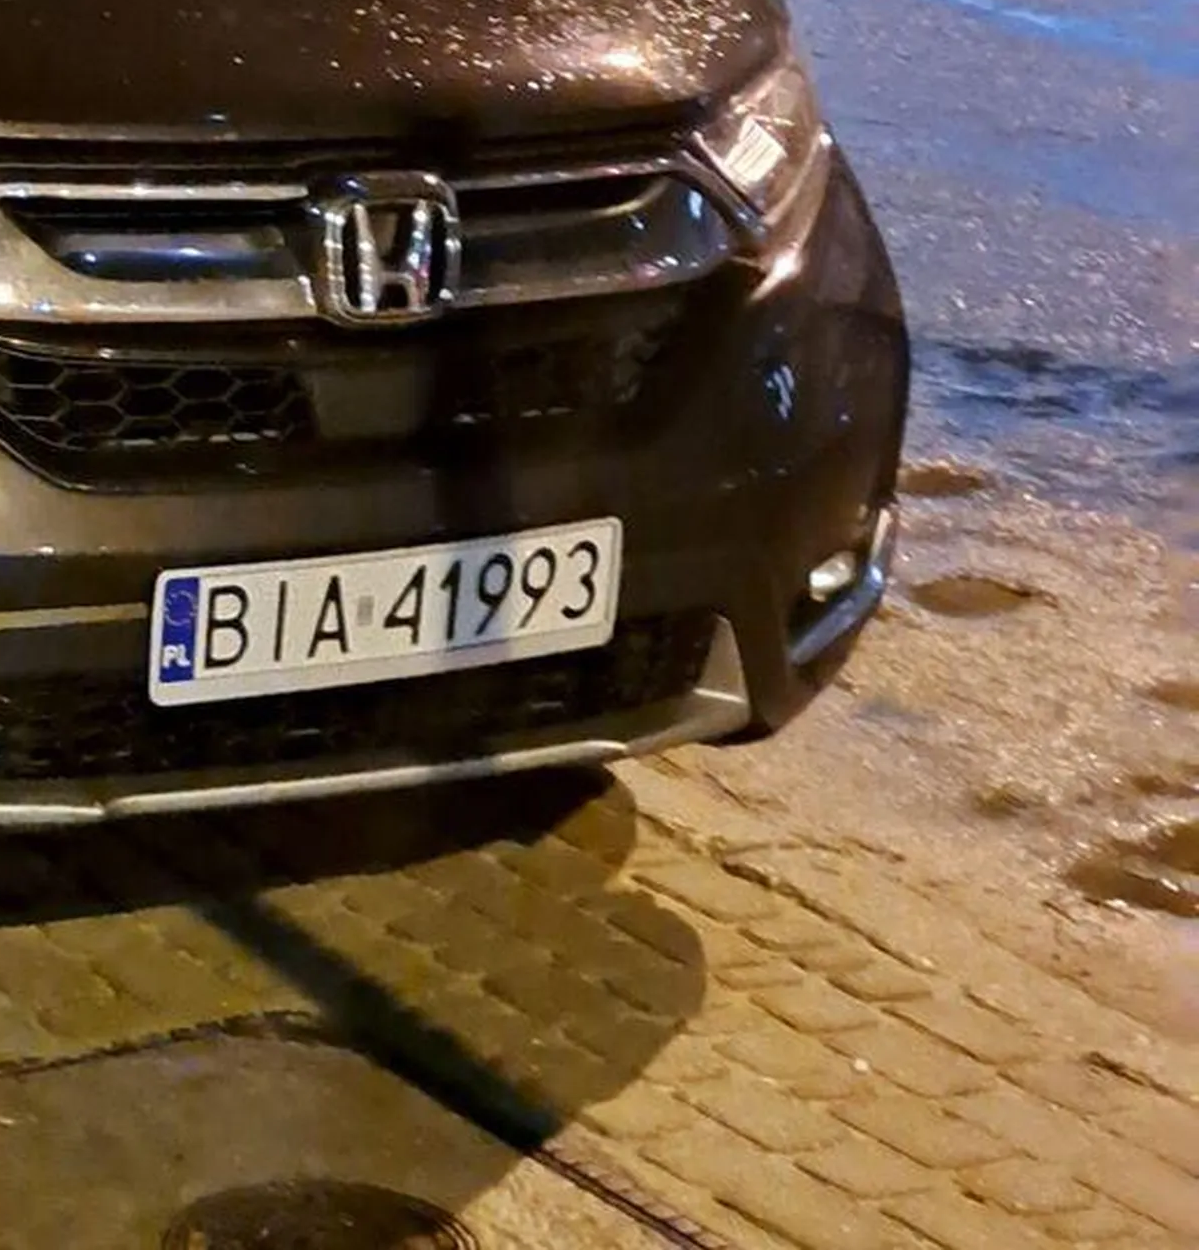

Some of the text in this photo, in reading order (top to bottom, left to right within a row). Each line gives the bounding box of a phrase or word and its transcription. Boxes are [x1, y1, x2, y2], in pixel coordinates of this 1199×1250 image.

[203, 540, 600, 670] BIA 41993
[162, 643, 191, 669] PL
